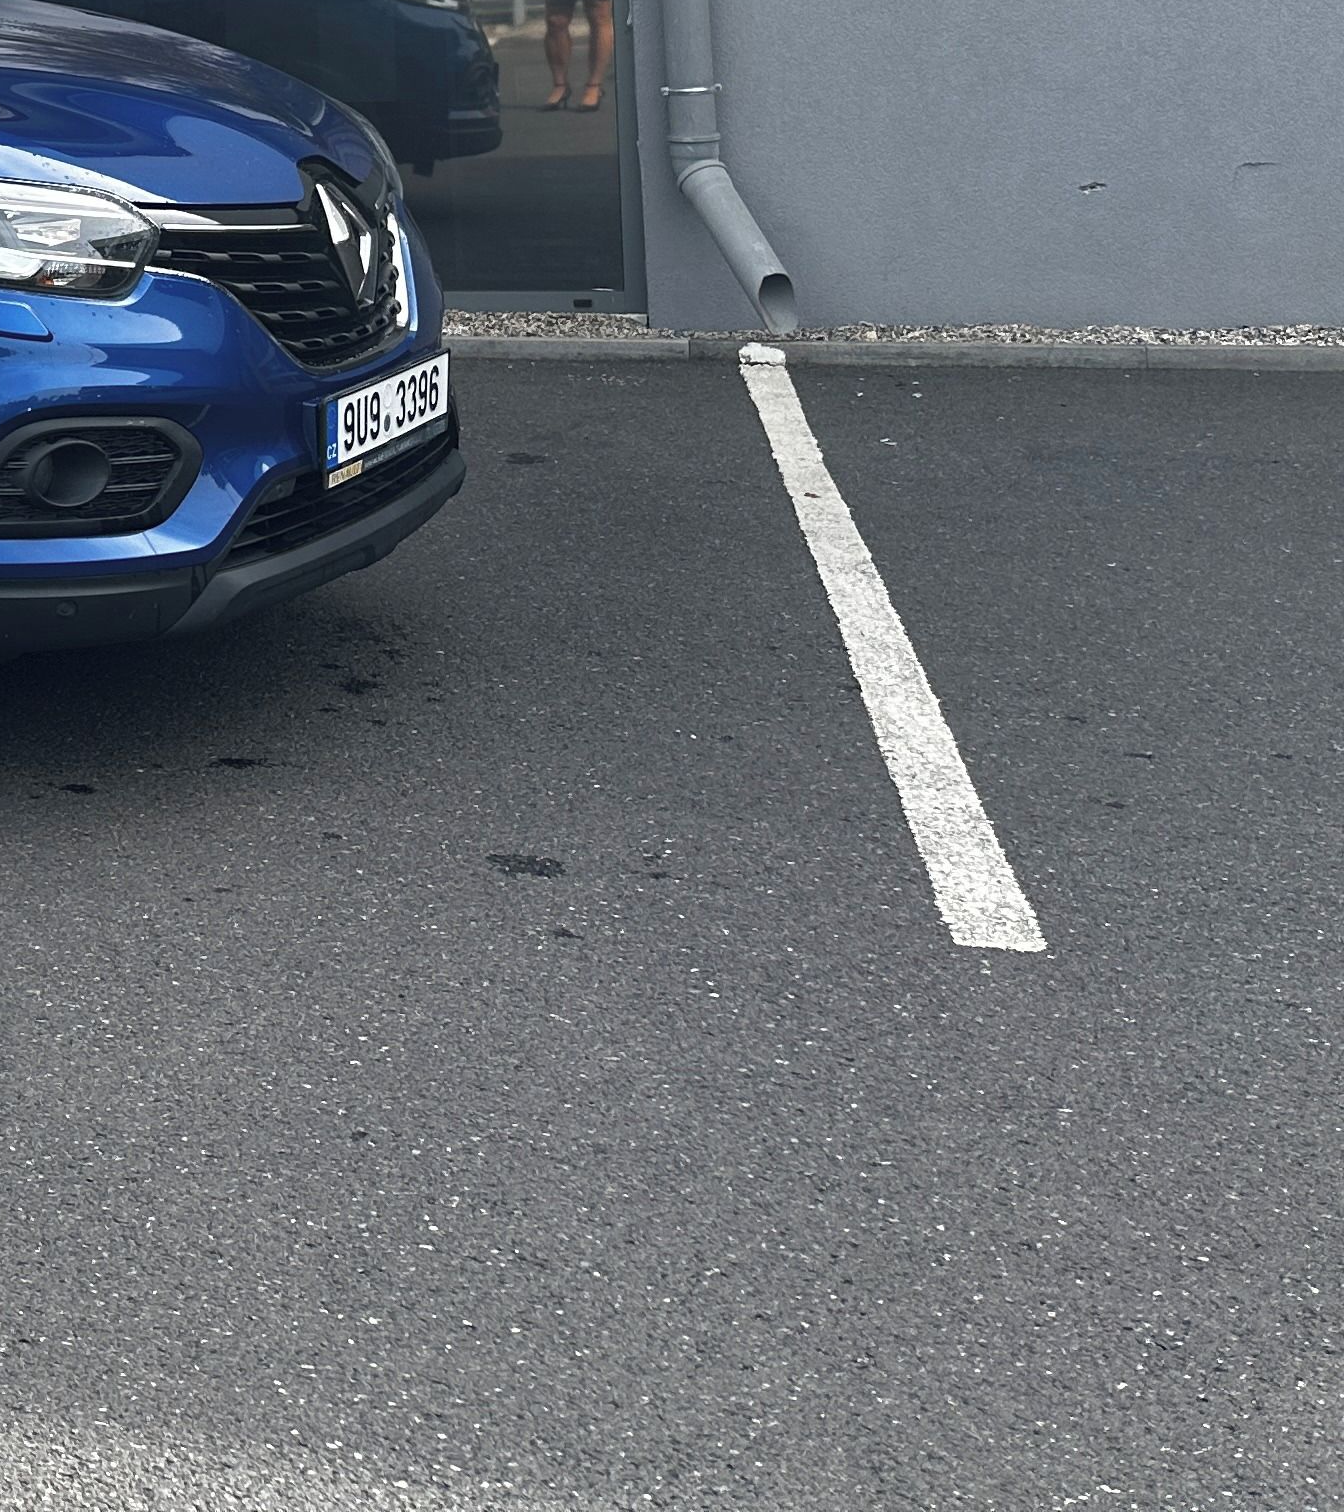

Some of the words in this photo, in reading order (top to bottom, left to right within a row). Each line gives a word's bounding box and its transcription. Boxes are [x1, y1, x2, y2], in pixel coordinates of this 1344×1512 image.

[343, 391, 381, 451] 9U9
[396, 365, 440, 428] 3396
[326, 442, 337, 460] CZ
